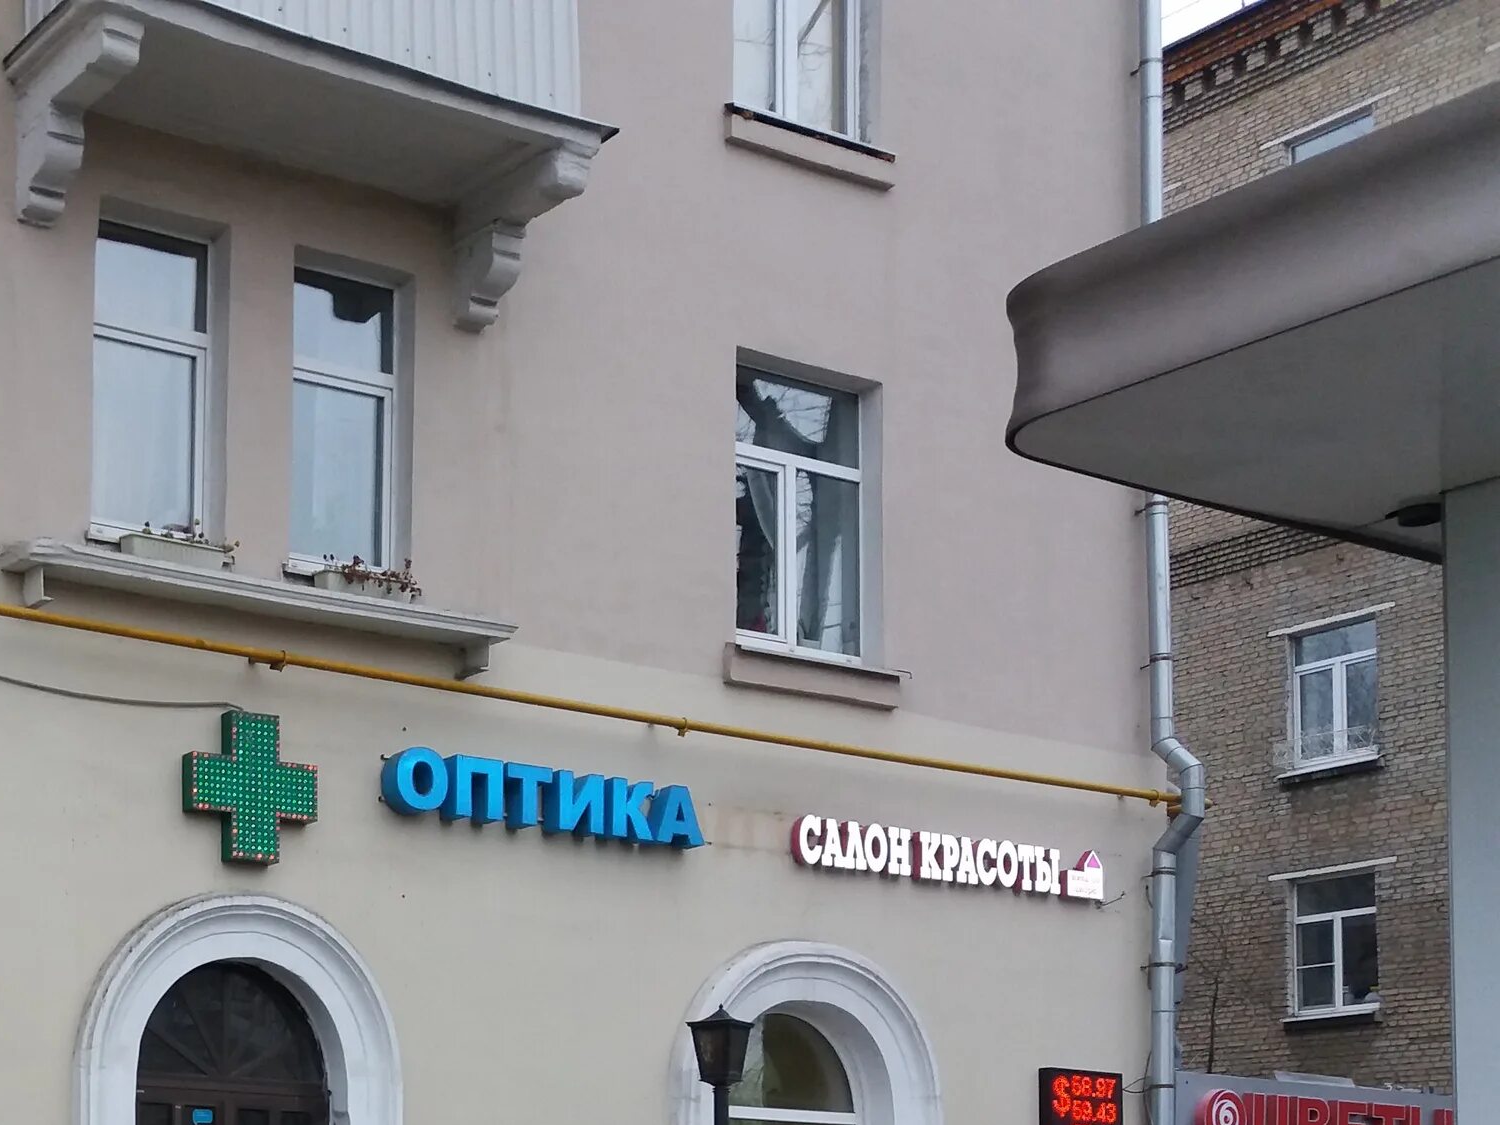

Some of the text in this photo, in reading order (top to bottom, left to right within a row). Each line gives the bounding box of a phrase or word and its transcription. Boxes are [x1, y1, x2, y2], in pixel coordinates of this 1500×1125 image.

[382, 746, 706, 850] ОПТИКА
[794, 814, 1061, 895] САЛОН КРАСОТЫ
